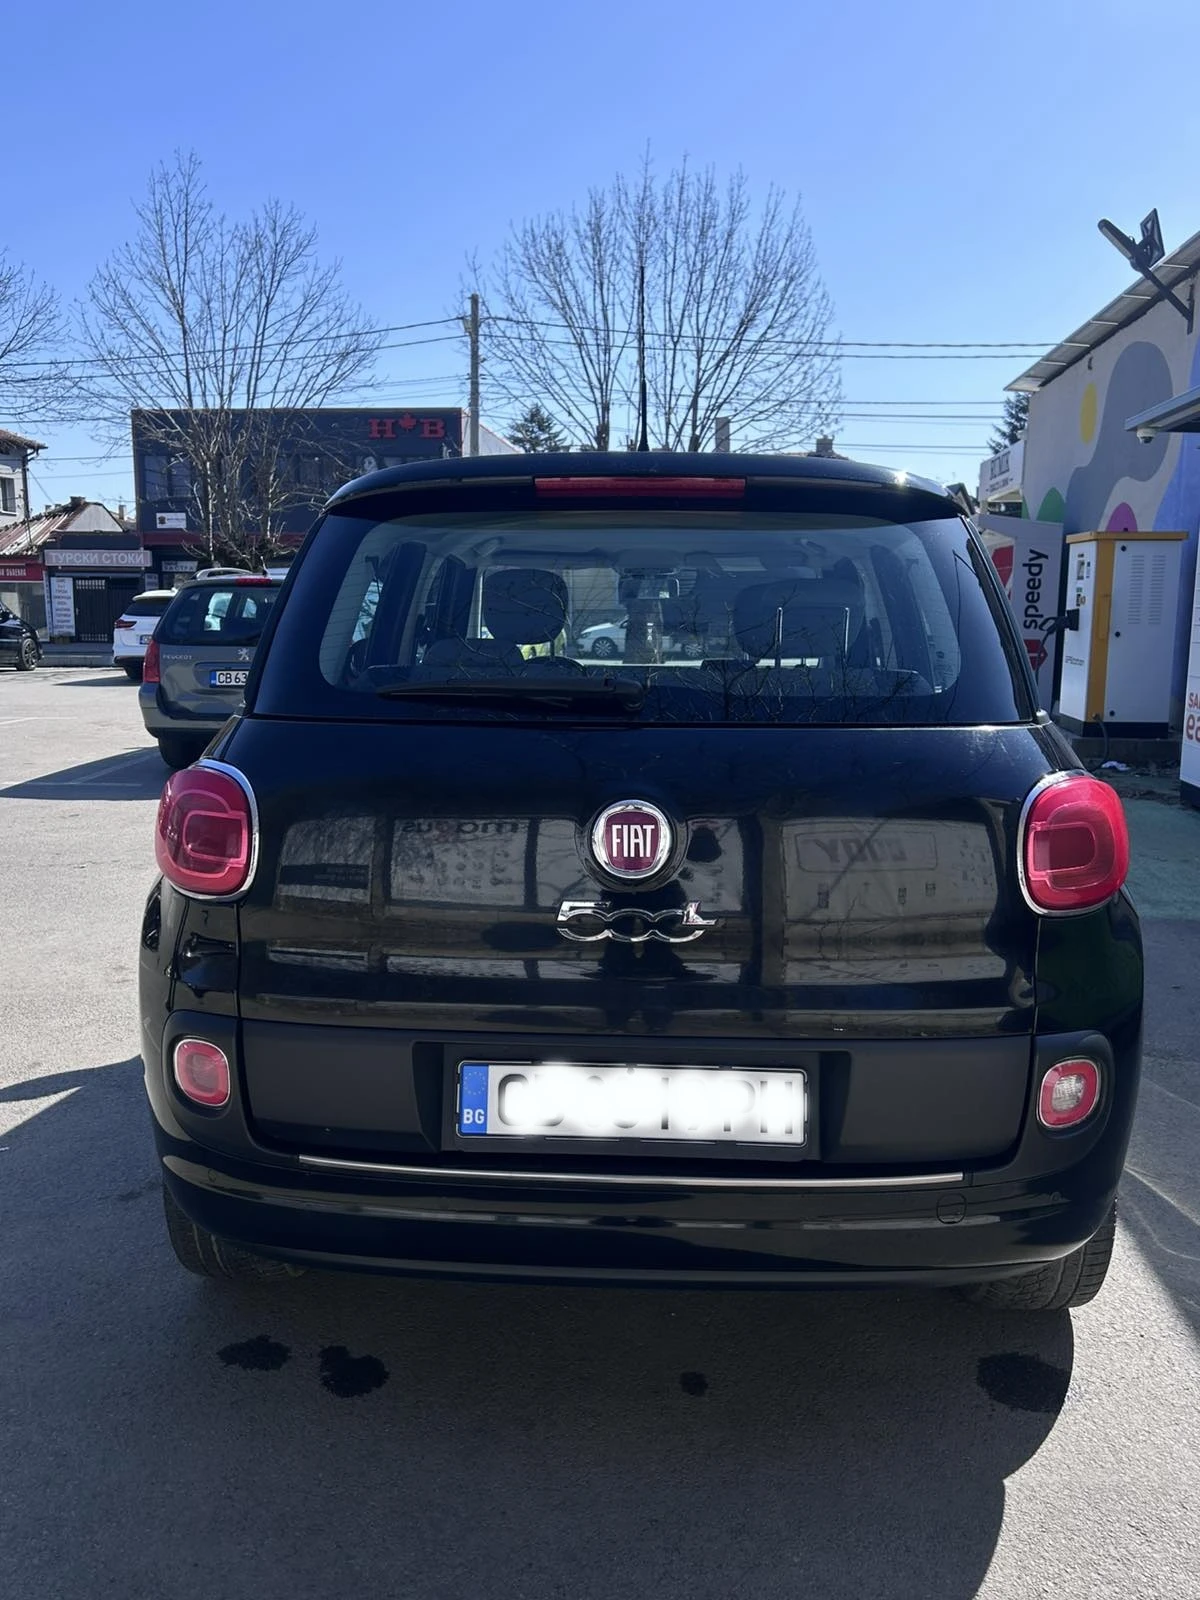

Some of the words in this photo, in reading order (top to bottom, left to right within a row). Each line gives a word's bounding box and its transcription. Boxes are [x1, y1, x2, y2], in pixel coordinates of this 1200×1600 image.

[368, 418, 397, 438] H
[420, 418, 446, 438] B
[50, 552, 100, 564] ТУРСКИ
[102, 552, 145, 565] СТОКИ
[1022, 548, 1049, 630] speedy
[217, 672, 232, 684] CB
[1188, 692, 1200, 710] SA
[611, 824, 656, 858] FIAT
[556, 900, 718, 943] 500L
[463, 1108, 485, 1124] BG
